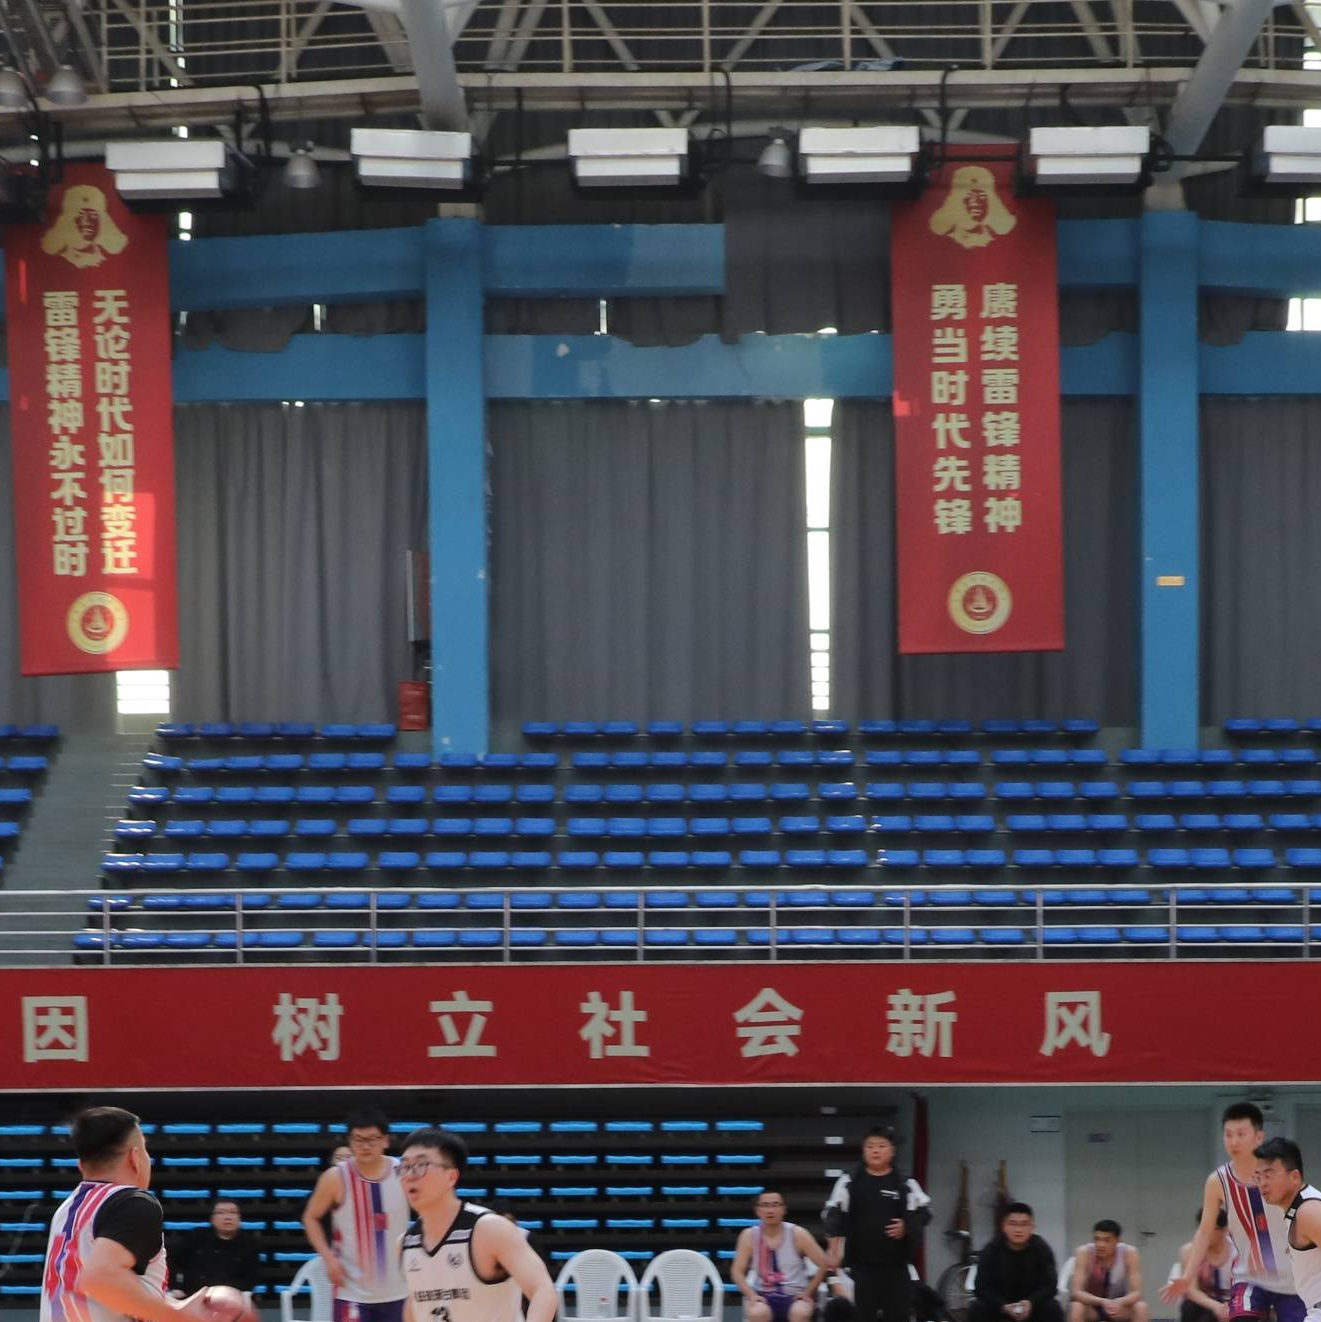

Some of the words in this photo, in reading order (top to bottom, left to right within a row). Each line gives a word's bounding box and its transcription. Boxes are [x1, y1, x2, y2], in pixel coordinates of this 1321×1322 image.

[43, 291, 89, 577] 雷锋精神永不过时
[92, 289, 139, 575] 无论时代如何变迁
[930, 283, 973, 535] 勇当时代先锋
[272, 988, 1112, 1061] 树立社会新风
